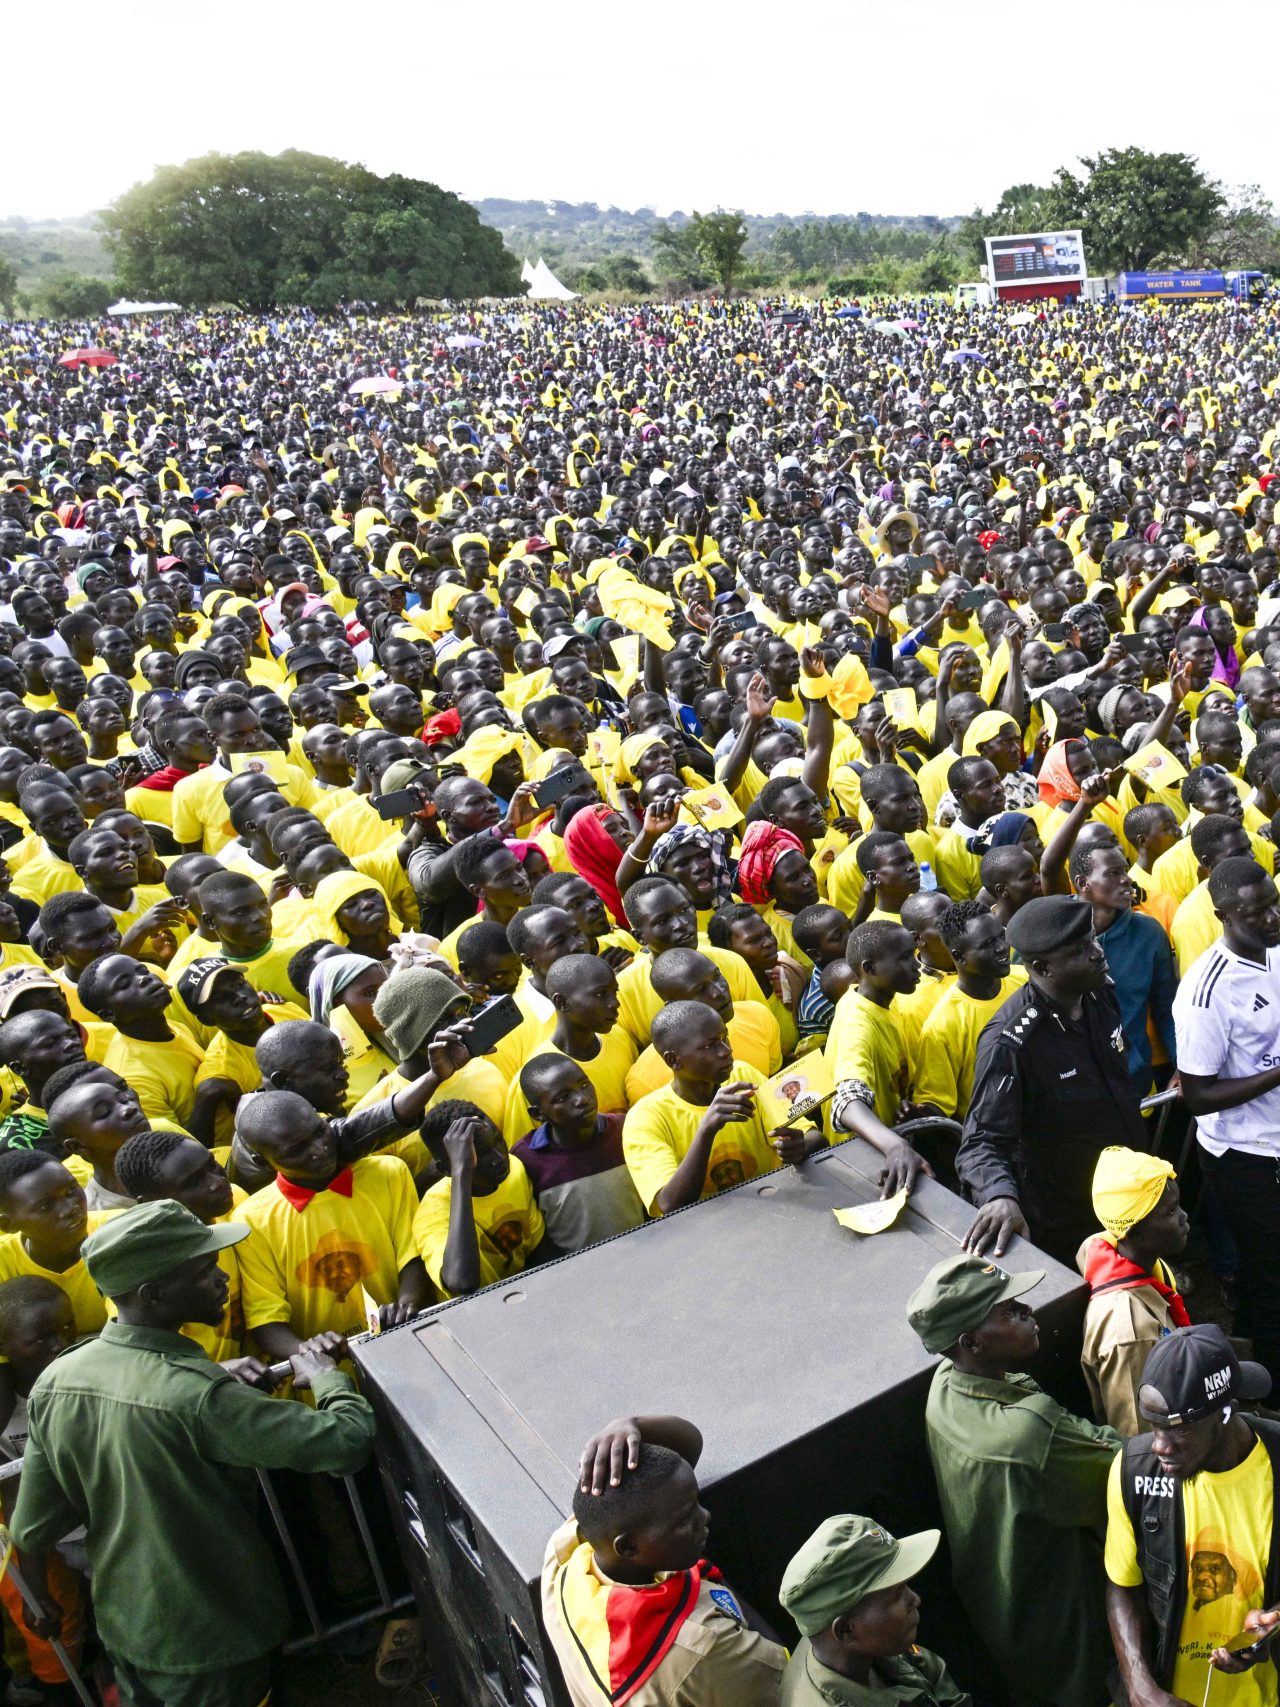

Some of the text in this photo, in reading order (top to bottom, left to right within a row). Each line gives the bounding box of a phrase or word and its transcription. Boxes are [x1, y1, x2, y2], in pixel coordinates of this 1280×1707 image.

[1146, 279, 1202, 289] WATER TANK
[188, 958, 227, 986] KING
[1002, 1029, 1023, 1046] UGANDA
[1203, 1365, 1232, 1393] NRM
[1207, 1391, 1216, 1400] MY
[1134, 1475, 1175, 1498] PRESS
